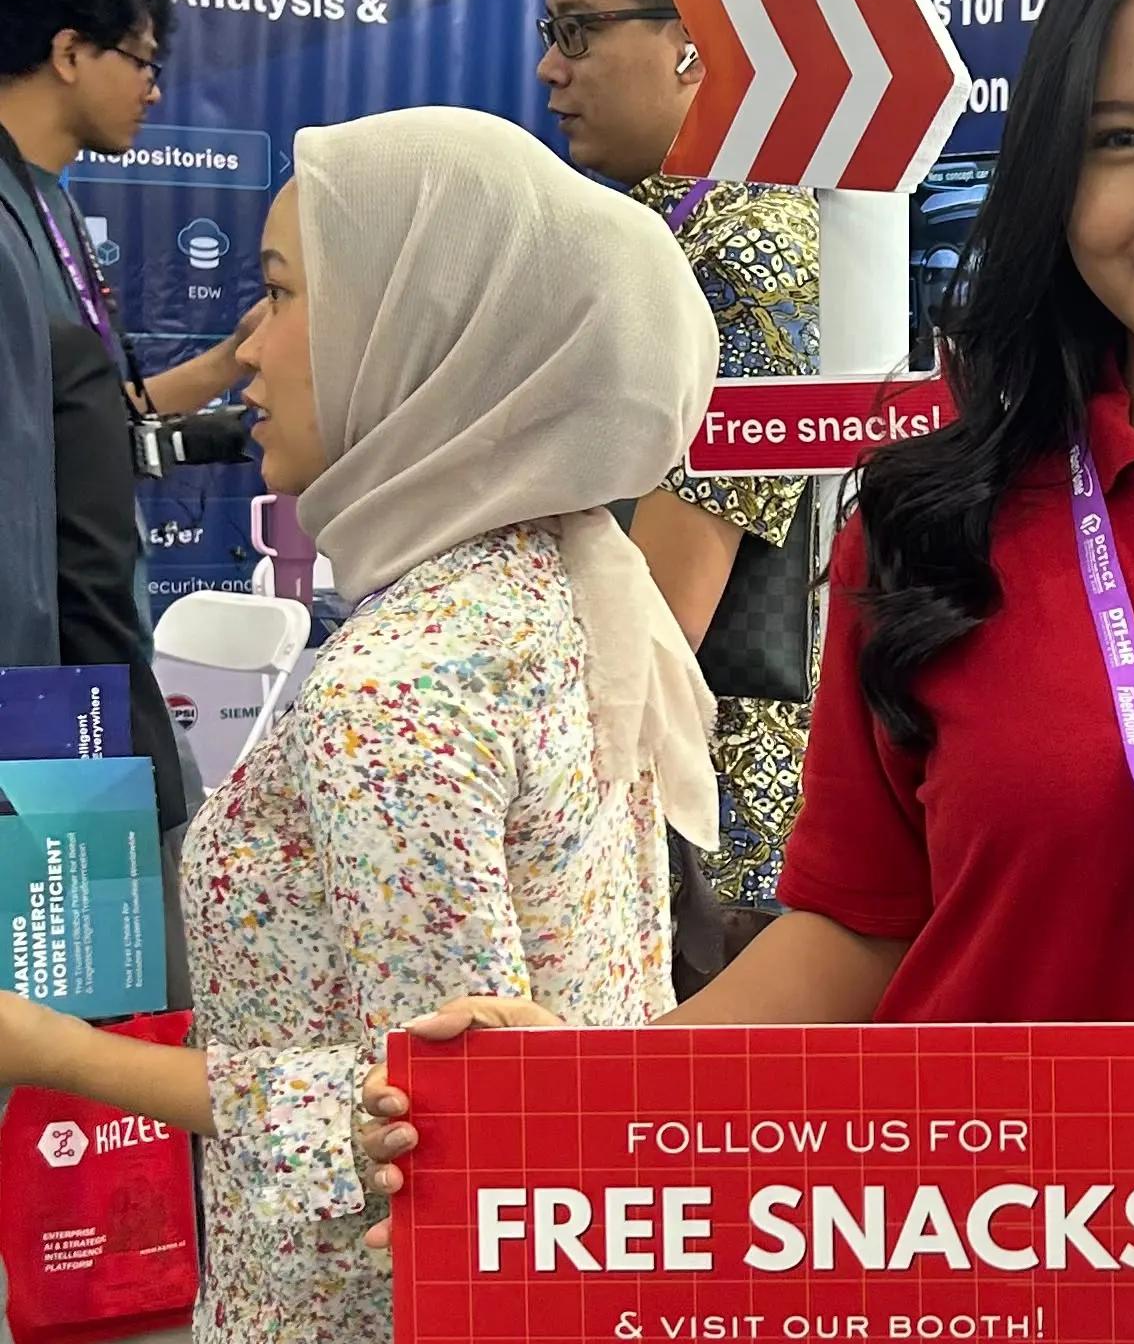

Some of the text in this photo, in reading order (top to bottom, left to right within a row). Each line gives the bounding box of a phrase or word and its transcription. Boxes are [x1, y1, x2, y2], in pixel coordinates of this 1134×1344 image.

[963, 76, 1010, 114] on
[187, 285, 223, 301] EDW
[705, 405, 941, 445] Free snacks!
[1094, 533, 1117, 591] DCTI-CX
[46, 837, 69, 998] MORE EFFICIENT
[13, 915, 29, 1000] MAKING
[30, 881, 48, 999] COMMERCE
[94, 1114, 170, 1155] KAZEE
[627, 1120, 1028, 1154] FOLLOW US FOR
[477, 1185, 714, 1273] FREE
[614, 1306, 1044, 1340] & VISIT OUR BOOTH!
